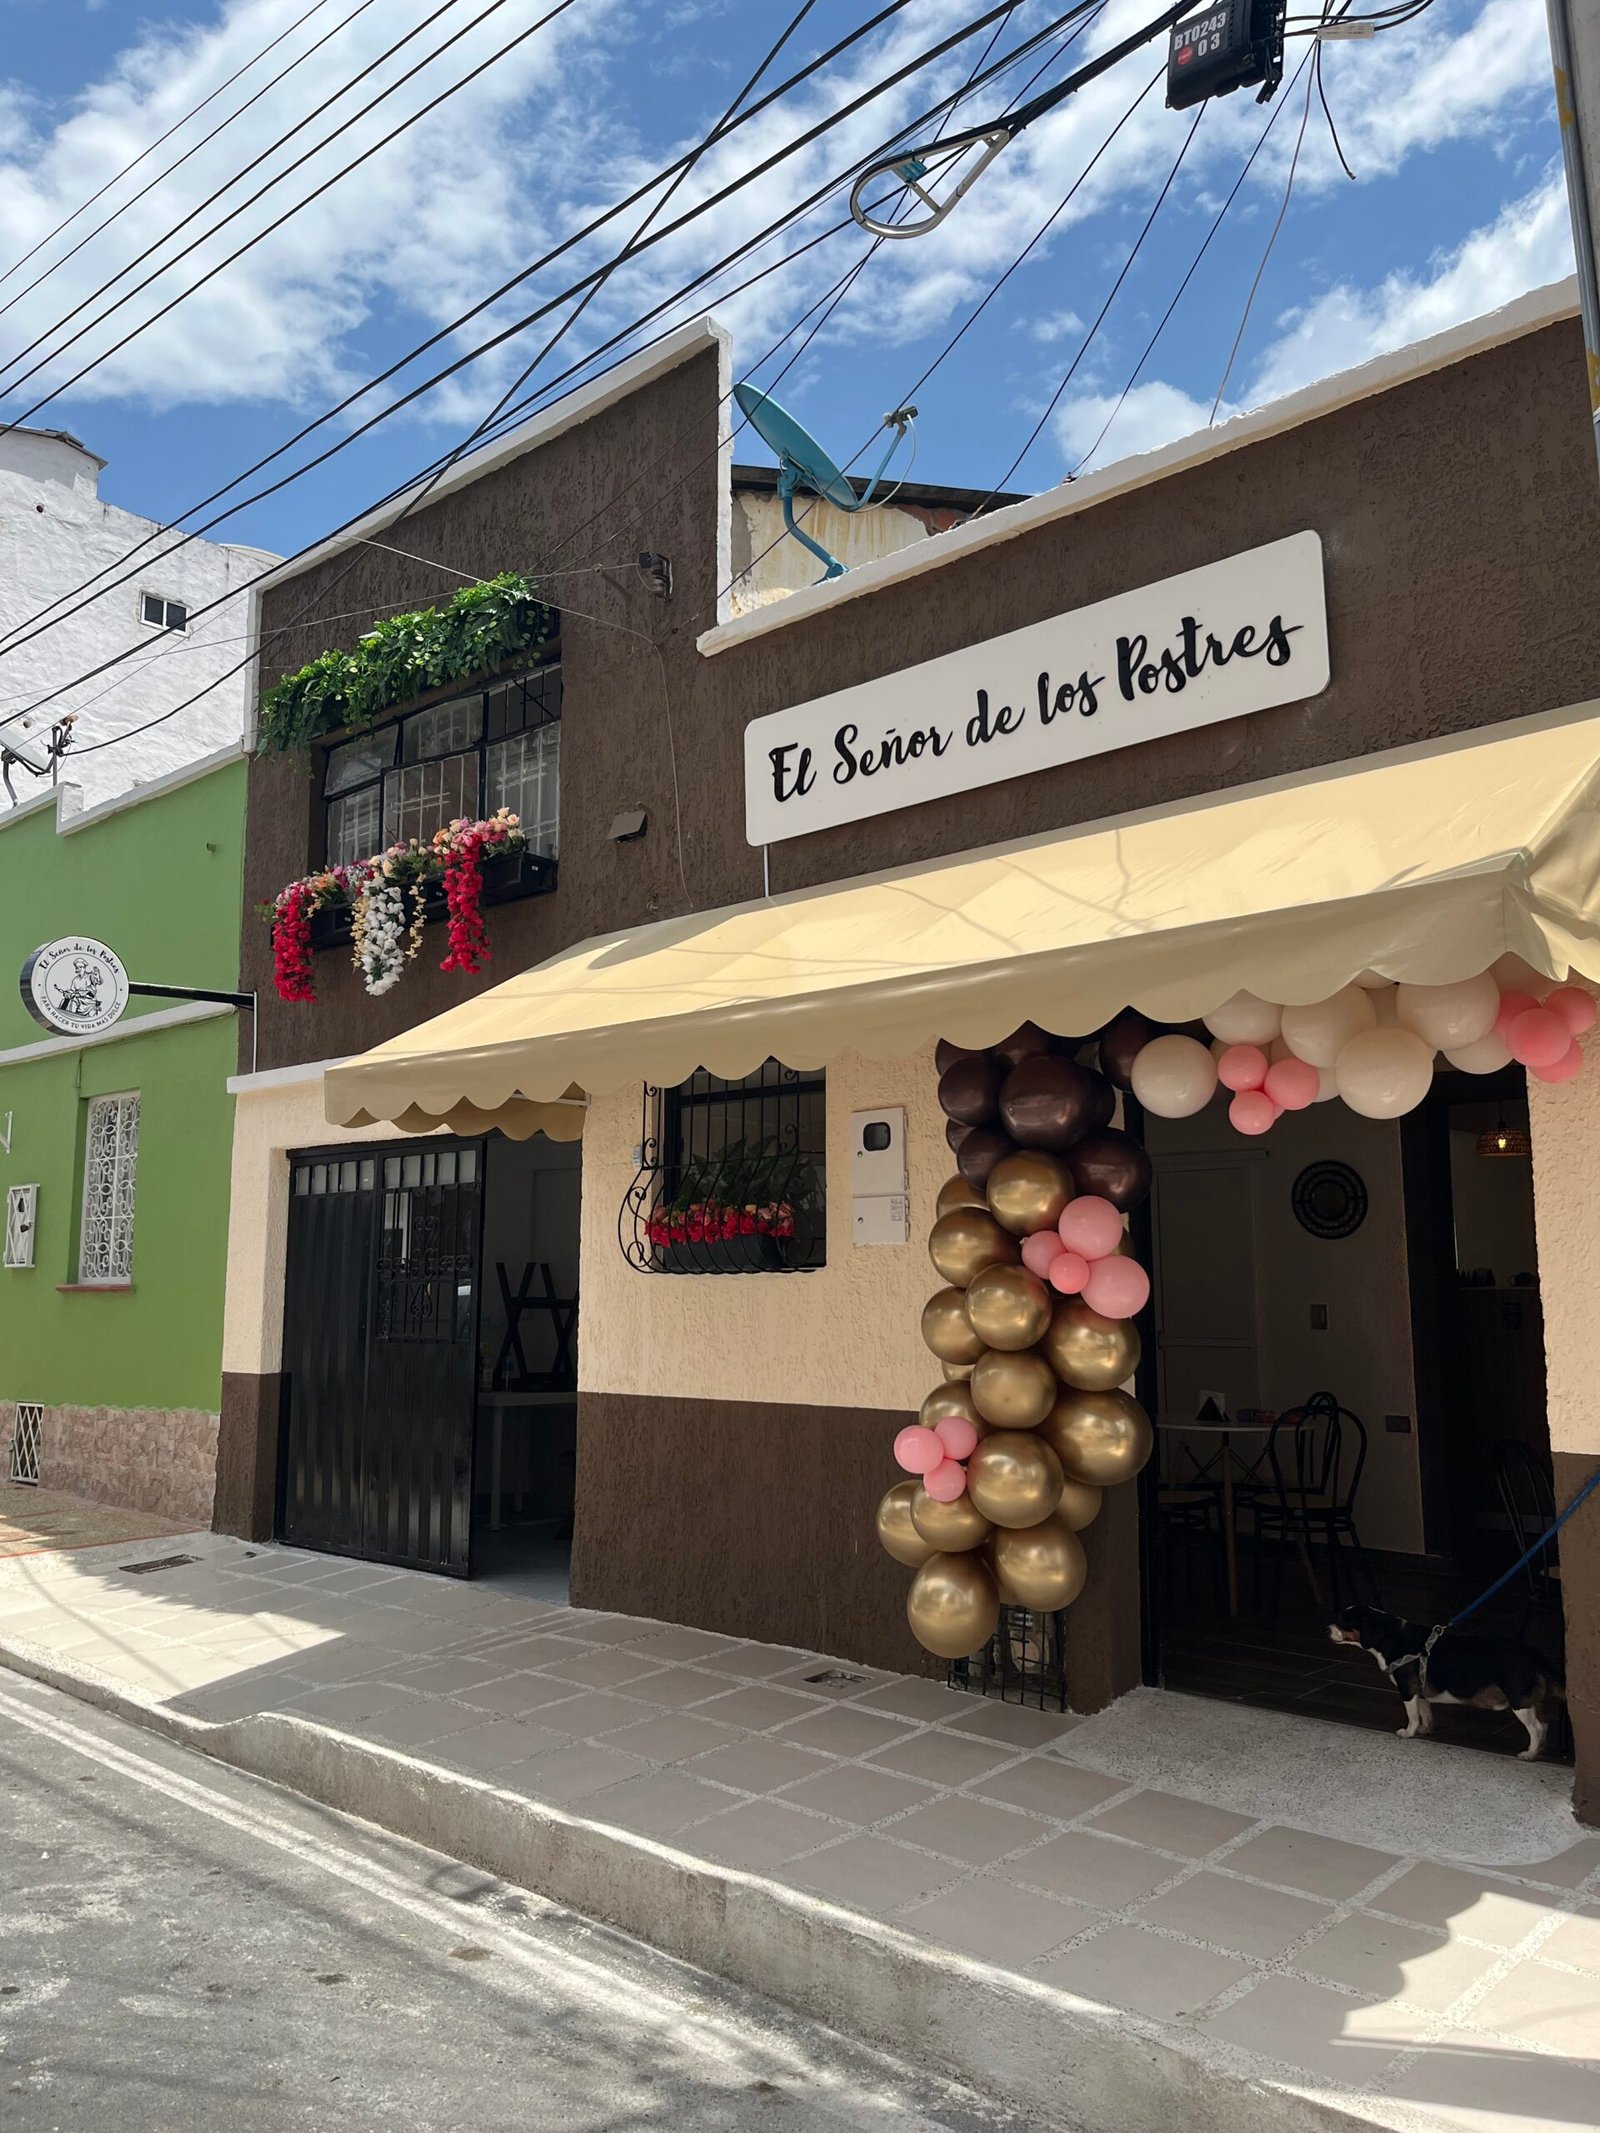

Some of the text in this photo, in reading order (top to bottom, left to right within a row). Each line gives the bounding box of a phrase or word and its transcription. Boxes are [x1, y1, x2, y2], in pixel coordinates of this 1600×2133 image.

[769, 614, 1305, 803] El Señor de los Postres
[39, 959, 49, 969] El
[73, 943, 84, 951] de
[86, 945, 97, 955] los
[99, 950, 119, 974] Postres
[41, 995, 52, 1012] PARA
[50, 1011, 69, 1026] HACER
[81, 1022, 96, 1030] VIDA
[107, 1001, 121, 1019] DULCE
